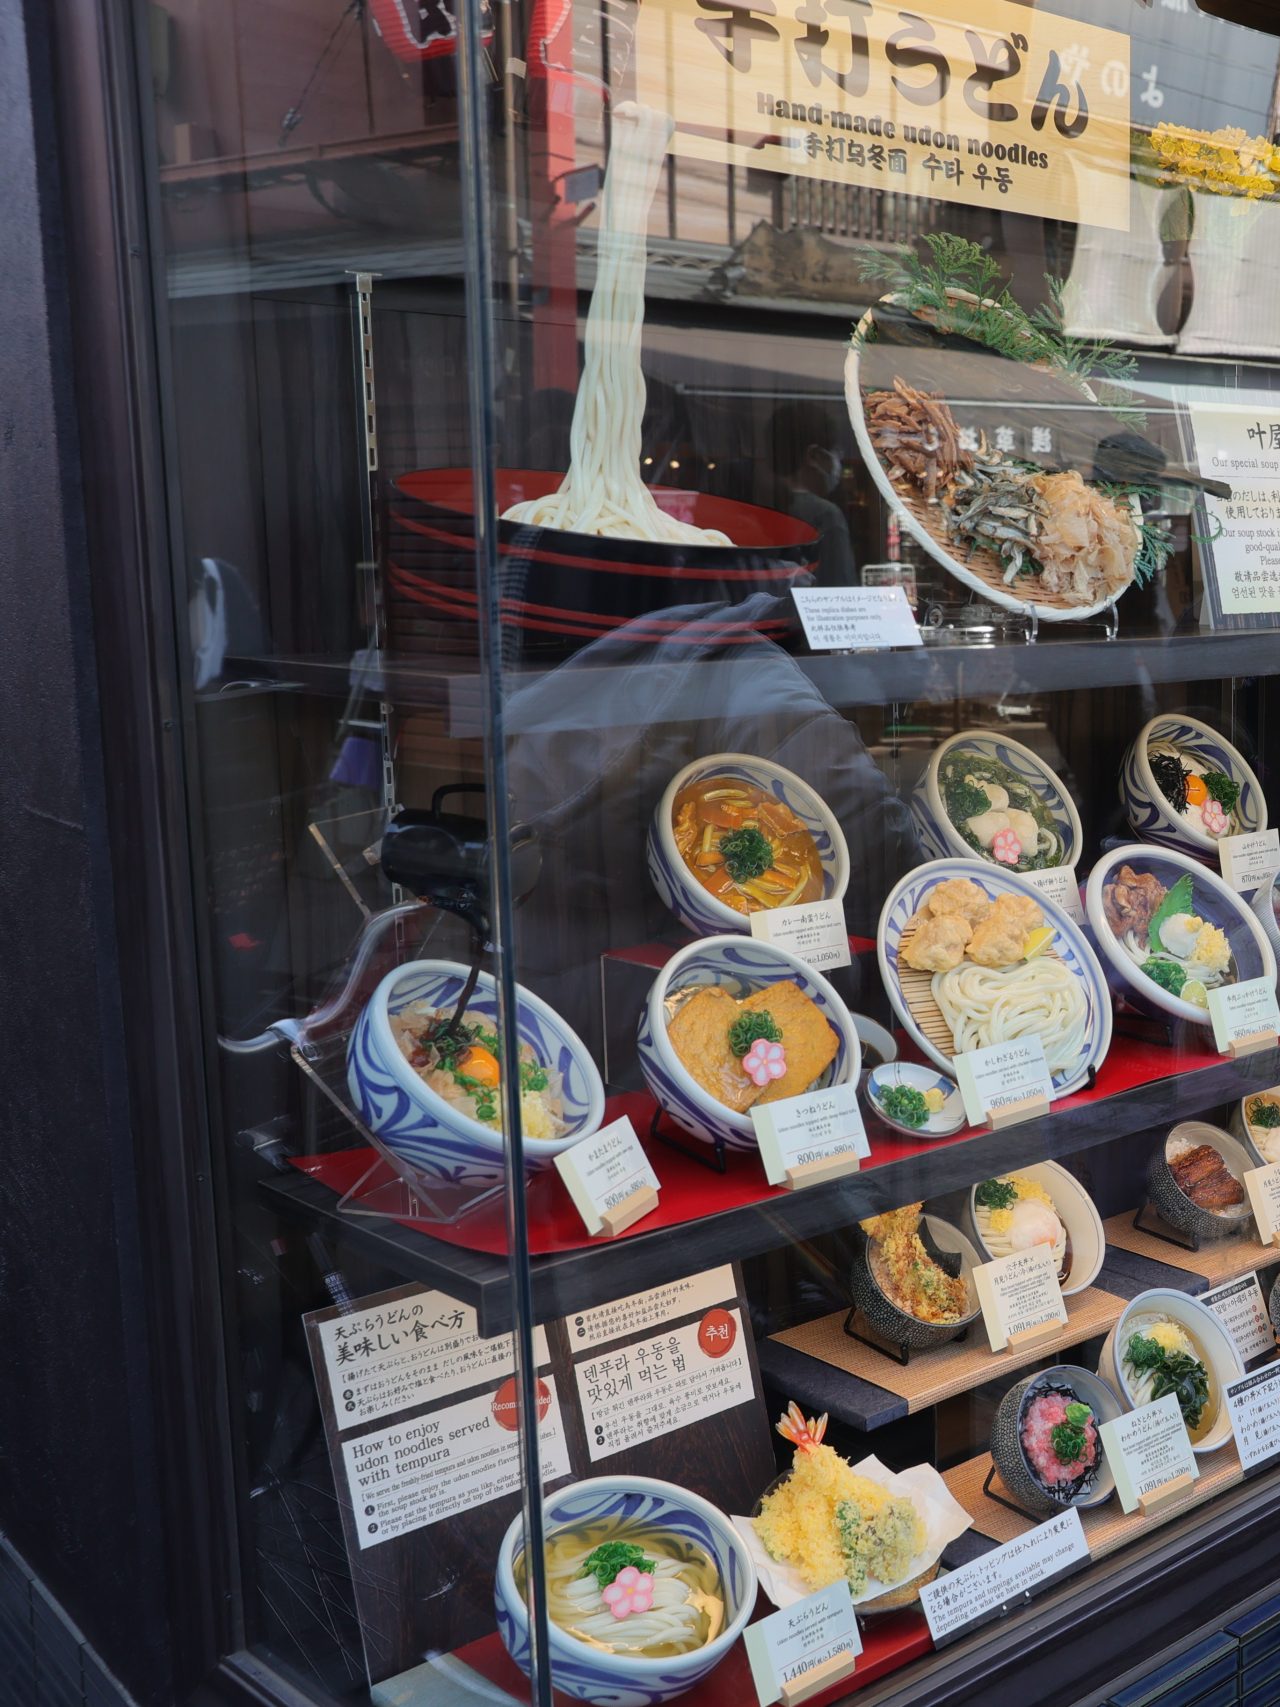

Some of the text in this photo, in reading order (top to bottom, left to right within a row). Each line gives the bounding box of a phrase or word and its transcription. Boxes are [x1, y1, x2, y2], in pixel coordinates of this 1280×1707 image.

[695, 0, 1088, 138] 手打うどん
[757, 92, 1048, 170] Hand-made udon noodles
[803, 132, 1014, 194] 手打乌冬面 수타 우동
[1212, 457, 1227, 467] Our
[1231, 458, 1258, 469] special
[1261, 460, 1278, 470] soup
[1222, 528, 1235, 537] Our
[1238, 529, 1254, 539] soup
[1256, 528, 1275, 537] stock
[796, 1101, 835, 1118] きつねうどん
[334, 1304, 423, 1340] 天ぷらうどんの
[336, 1309, 464, 1365] 美味しい食べ方
[704, 1320, 730, 1342] 추천
[583, 1336, 680, 1383] 덴푸라 우동을
[586, 1353, 685, 1404] 맛있게 먹는 법
[352, 1420, 439, 1458] How to enjoy
[355, 1416, 490, 1472] udon noodles served
[358, 1448, 450, 1486] with tempura
[376, 1462, 496, 1510] First, please enjoy the udon noodles
[378, 1494, 427, 1517] the soup stock
[380, 1472, 514, 1527] Please eat the tempura you like, either
[390, 1477, 522, 1532] by placing directly top the udon
[933, 1542, 1074, 1624] The tempura and toppings available may change
[935, 1568, 1045, 1633] depending on what we have in stock.
[788, 1603, 829, 1628] 天ぷらうどん
